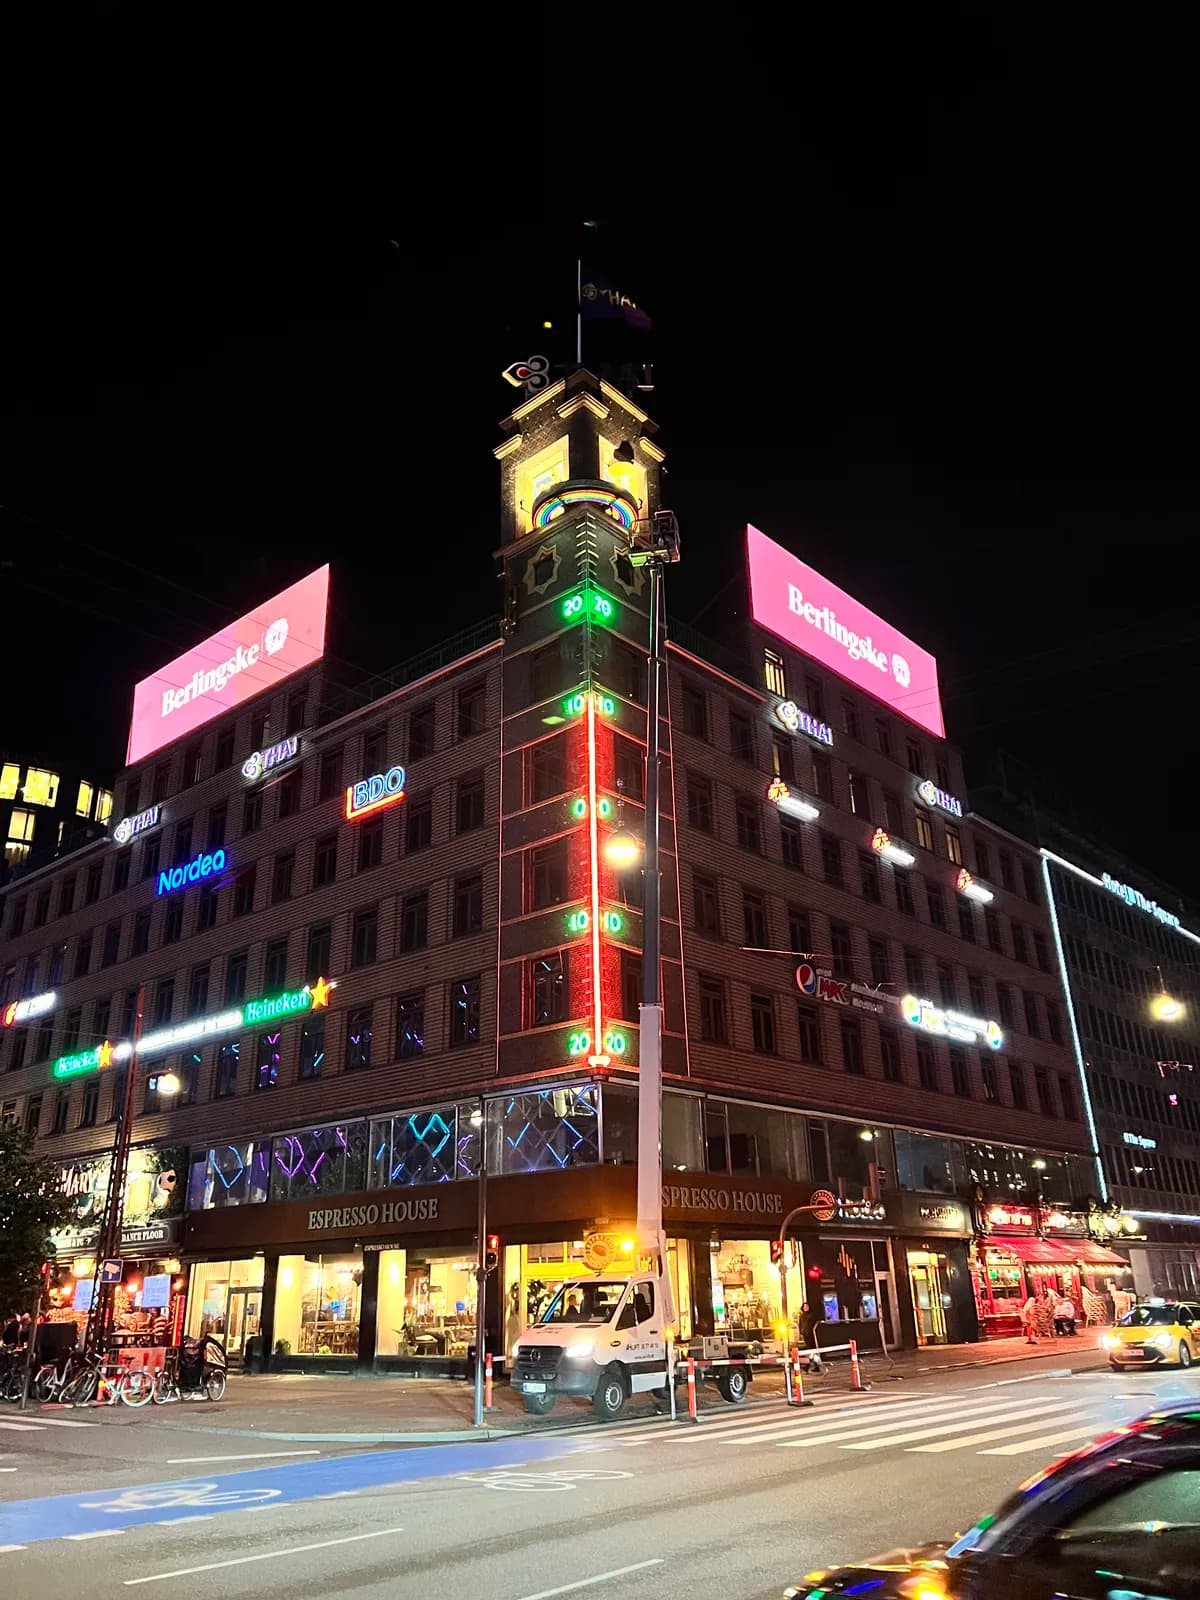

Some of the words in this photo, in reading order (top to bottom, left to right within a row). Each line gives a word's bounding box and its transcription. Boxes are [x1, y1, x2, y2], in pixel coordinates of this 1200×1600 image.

[563, 595, 582, 617] 20
[595, 595, 611, 617] 20
[787, 583, 888, 673] Berlingske
[161, 642, 260, 717] Berlingske
[567, 694, 583, 715] 10
[599, 695, 614, 715] 10
[799, 709, 834, 746] THAI
[261, 736, 298, 770] THAI
[353, 766, 405, 809] BDO
[574, 798, 586, 817] 0
[599, 798, 611, 816] 0
[935, 787, 963, 817] THAI
[130, 806, 160, 834] THAI
[157, 849, 225, 895] Nordea
[570, 911, 589, 931] 10
[604, 912, 621, 931] 10
[247, 990, 309, 1022] Heineken
[569, 1033, 590, 1055] 20
[606, 1032, 626, 1053] 20
[57, 1049, 101, 1075] Heineken
[661, 1185, 729, 1211] SPRESSO
[732, 1191, 783, 1214] HOUSE
[308, 1204, 379, 1230] ESPRESSO
[382, 1198, 438, 1223] HOUSE
[142, 1229, 164, 1241] FLOOR
